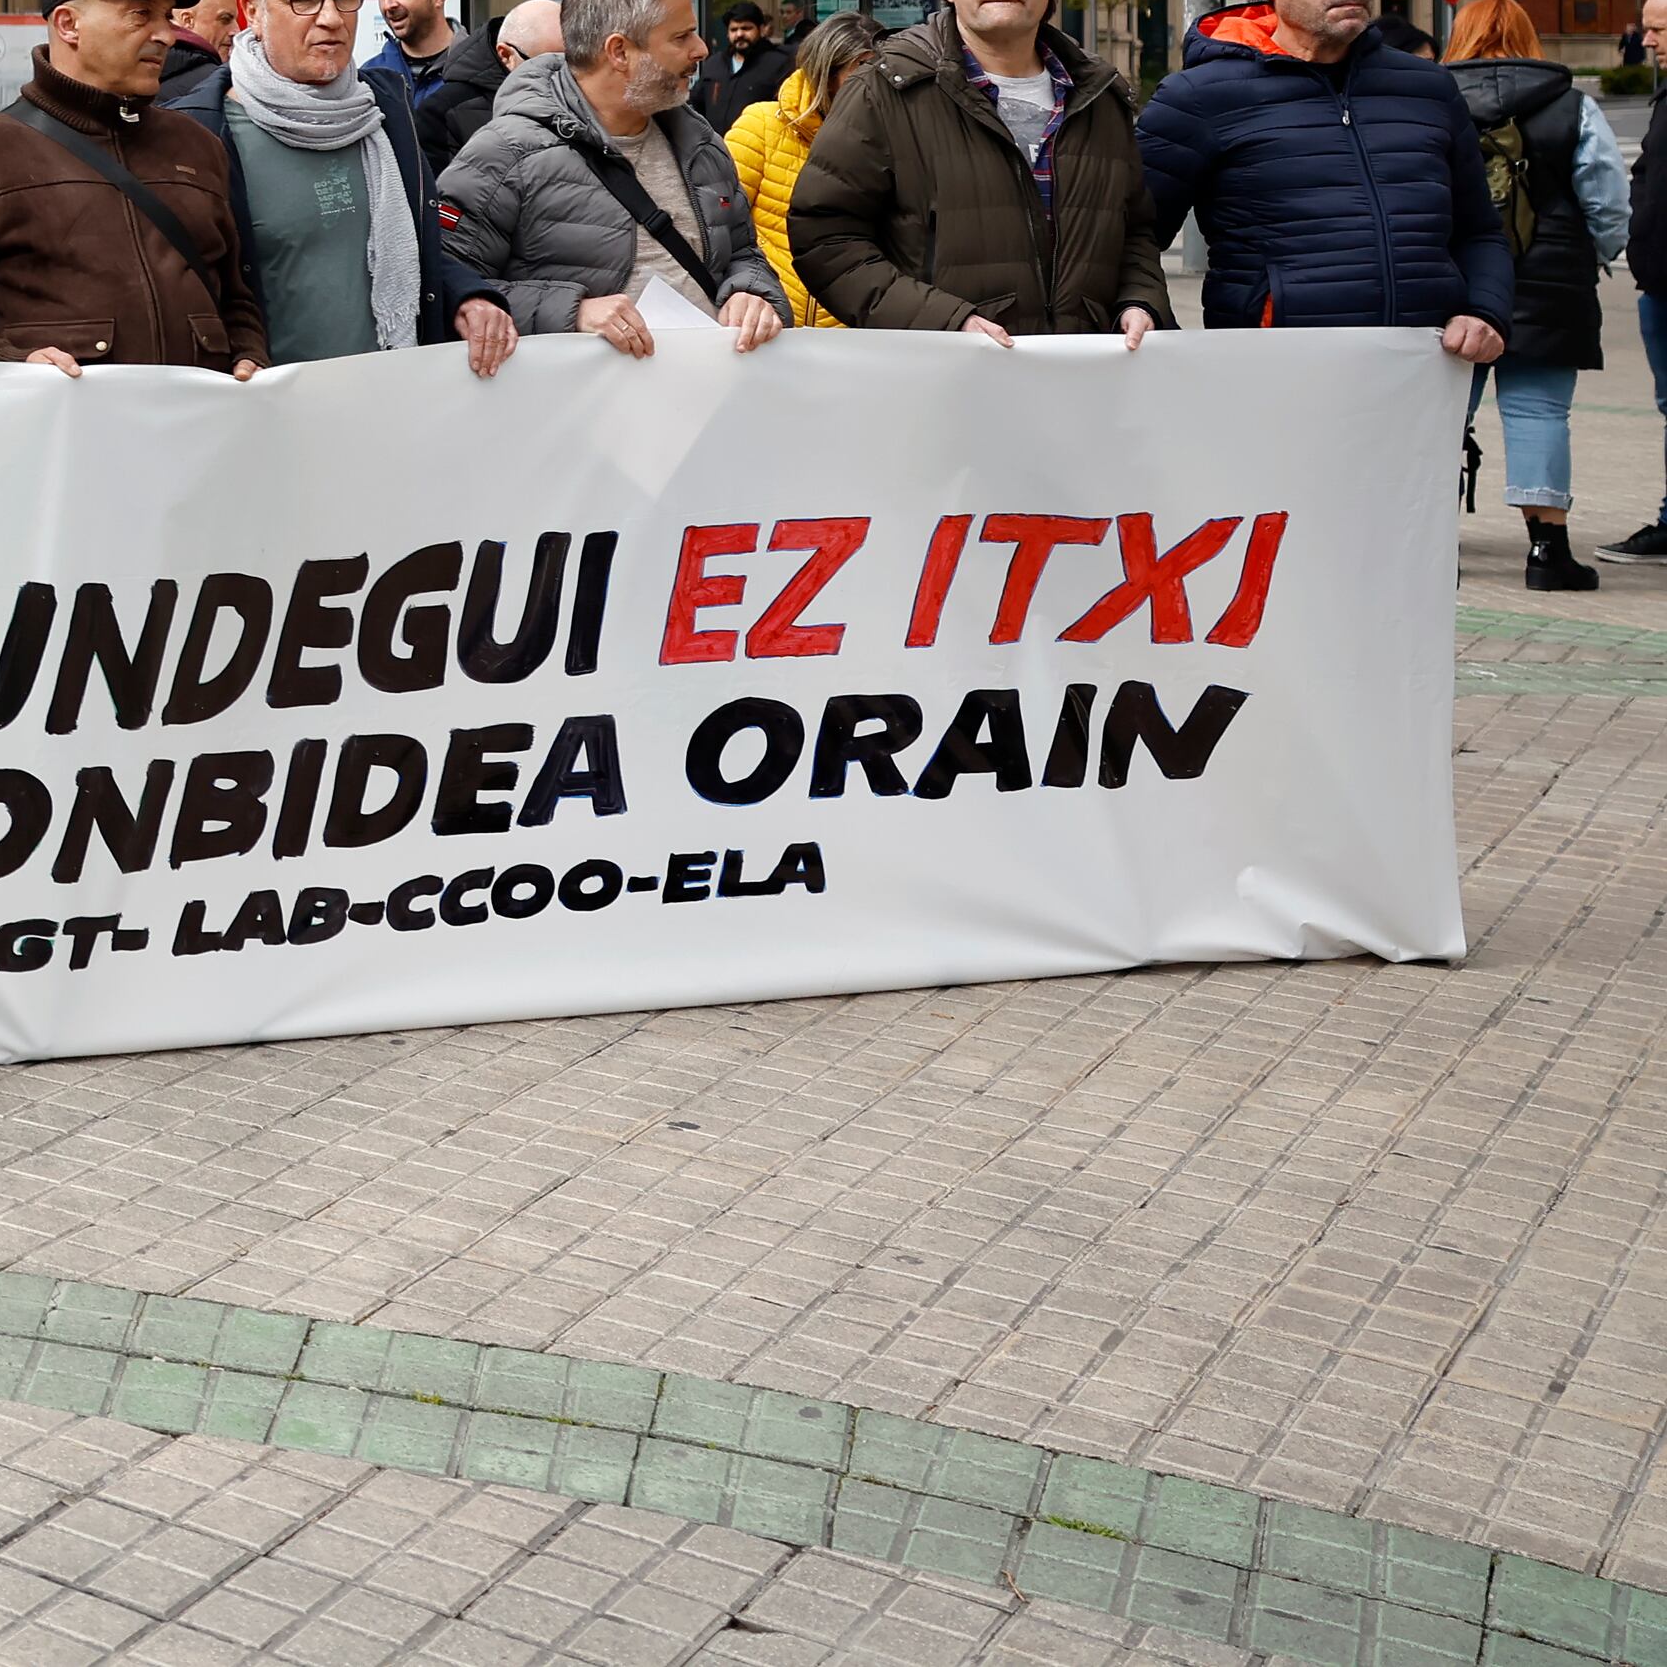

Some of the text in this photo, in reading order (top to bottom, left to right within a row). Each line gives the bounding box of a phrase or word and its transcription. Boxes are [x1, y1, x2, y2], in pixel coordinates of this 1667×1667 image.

[658, 516, 871, 666] EZ
[904, 511, 1288, 648] ITXI
[685, 680, 1251, 805] ORAIN
